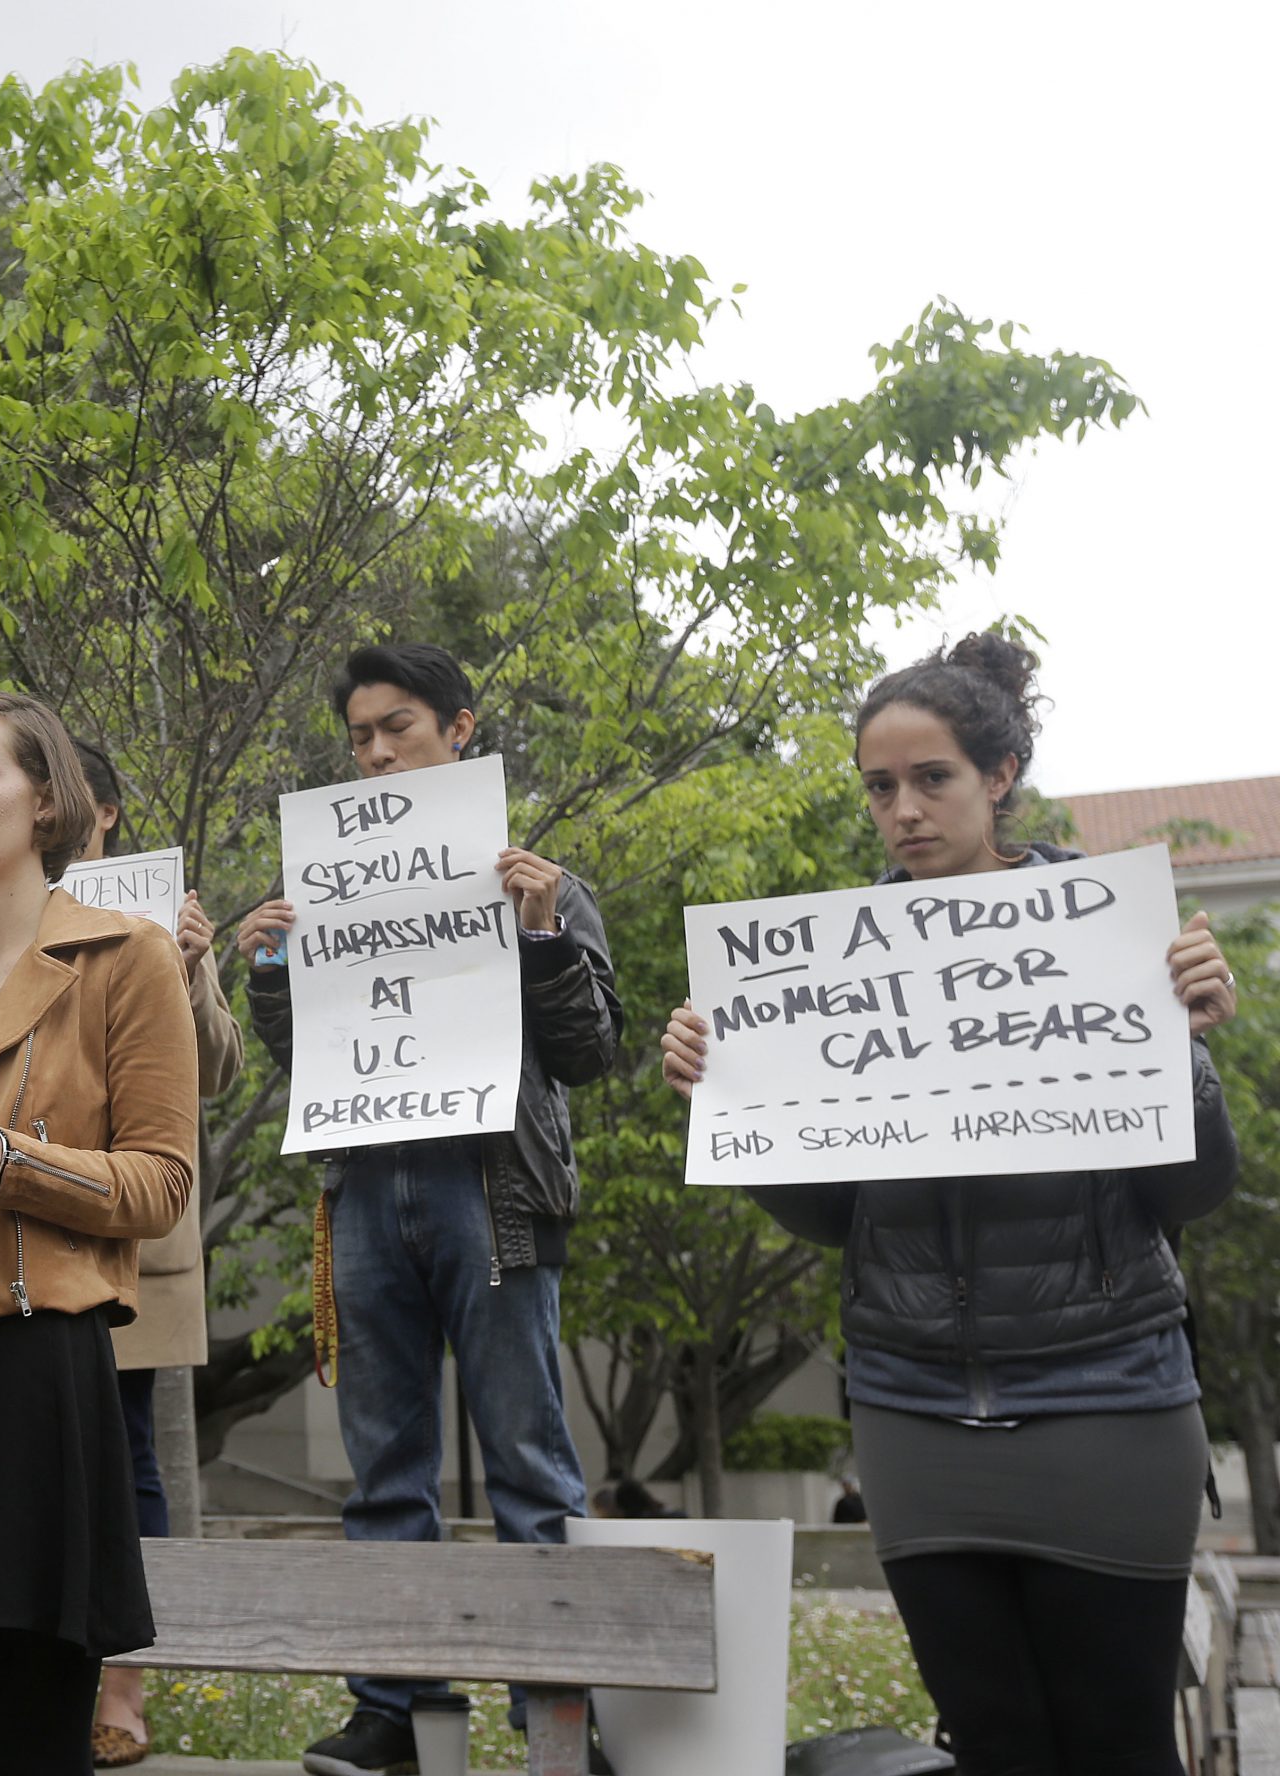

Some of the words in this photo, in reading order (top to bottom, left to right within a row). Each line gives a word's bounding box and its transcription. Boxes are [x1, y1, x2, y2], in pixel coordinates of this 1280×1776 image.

[330, 792, 413, 838] END
[301, 844, 476, 904] SEXUAL
[301, 902, 508, 967] HARASSMENT
[718, 915, 817, 966] NOT
[842, 906, 895, 959] A
[906, 878, 1116, 939] PROUD
[370, 976, 415, 1015] AT
[712, 971, 914, 1041] MOMENT
[935, 948, 1068, 1000] FOR
[353, 1035, 425, 1076] U.C.
[821, 1027, 932, 1074] CAL
[949, 1002, 1152, 1052] BEARS
[303, 1084, 496, 1133] BERKELEY
[711, 1130, 773, 1161] END
[798, 1120, 928, 1151] SEXUAL
[952, 1105, 1168, 1142] HARASSMENT
